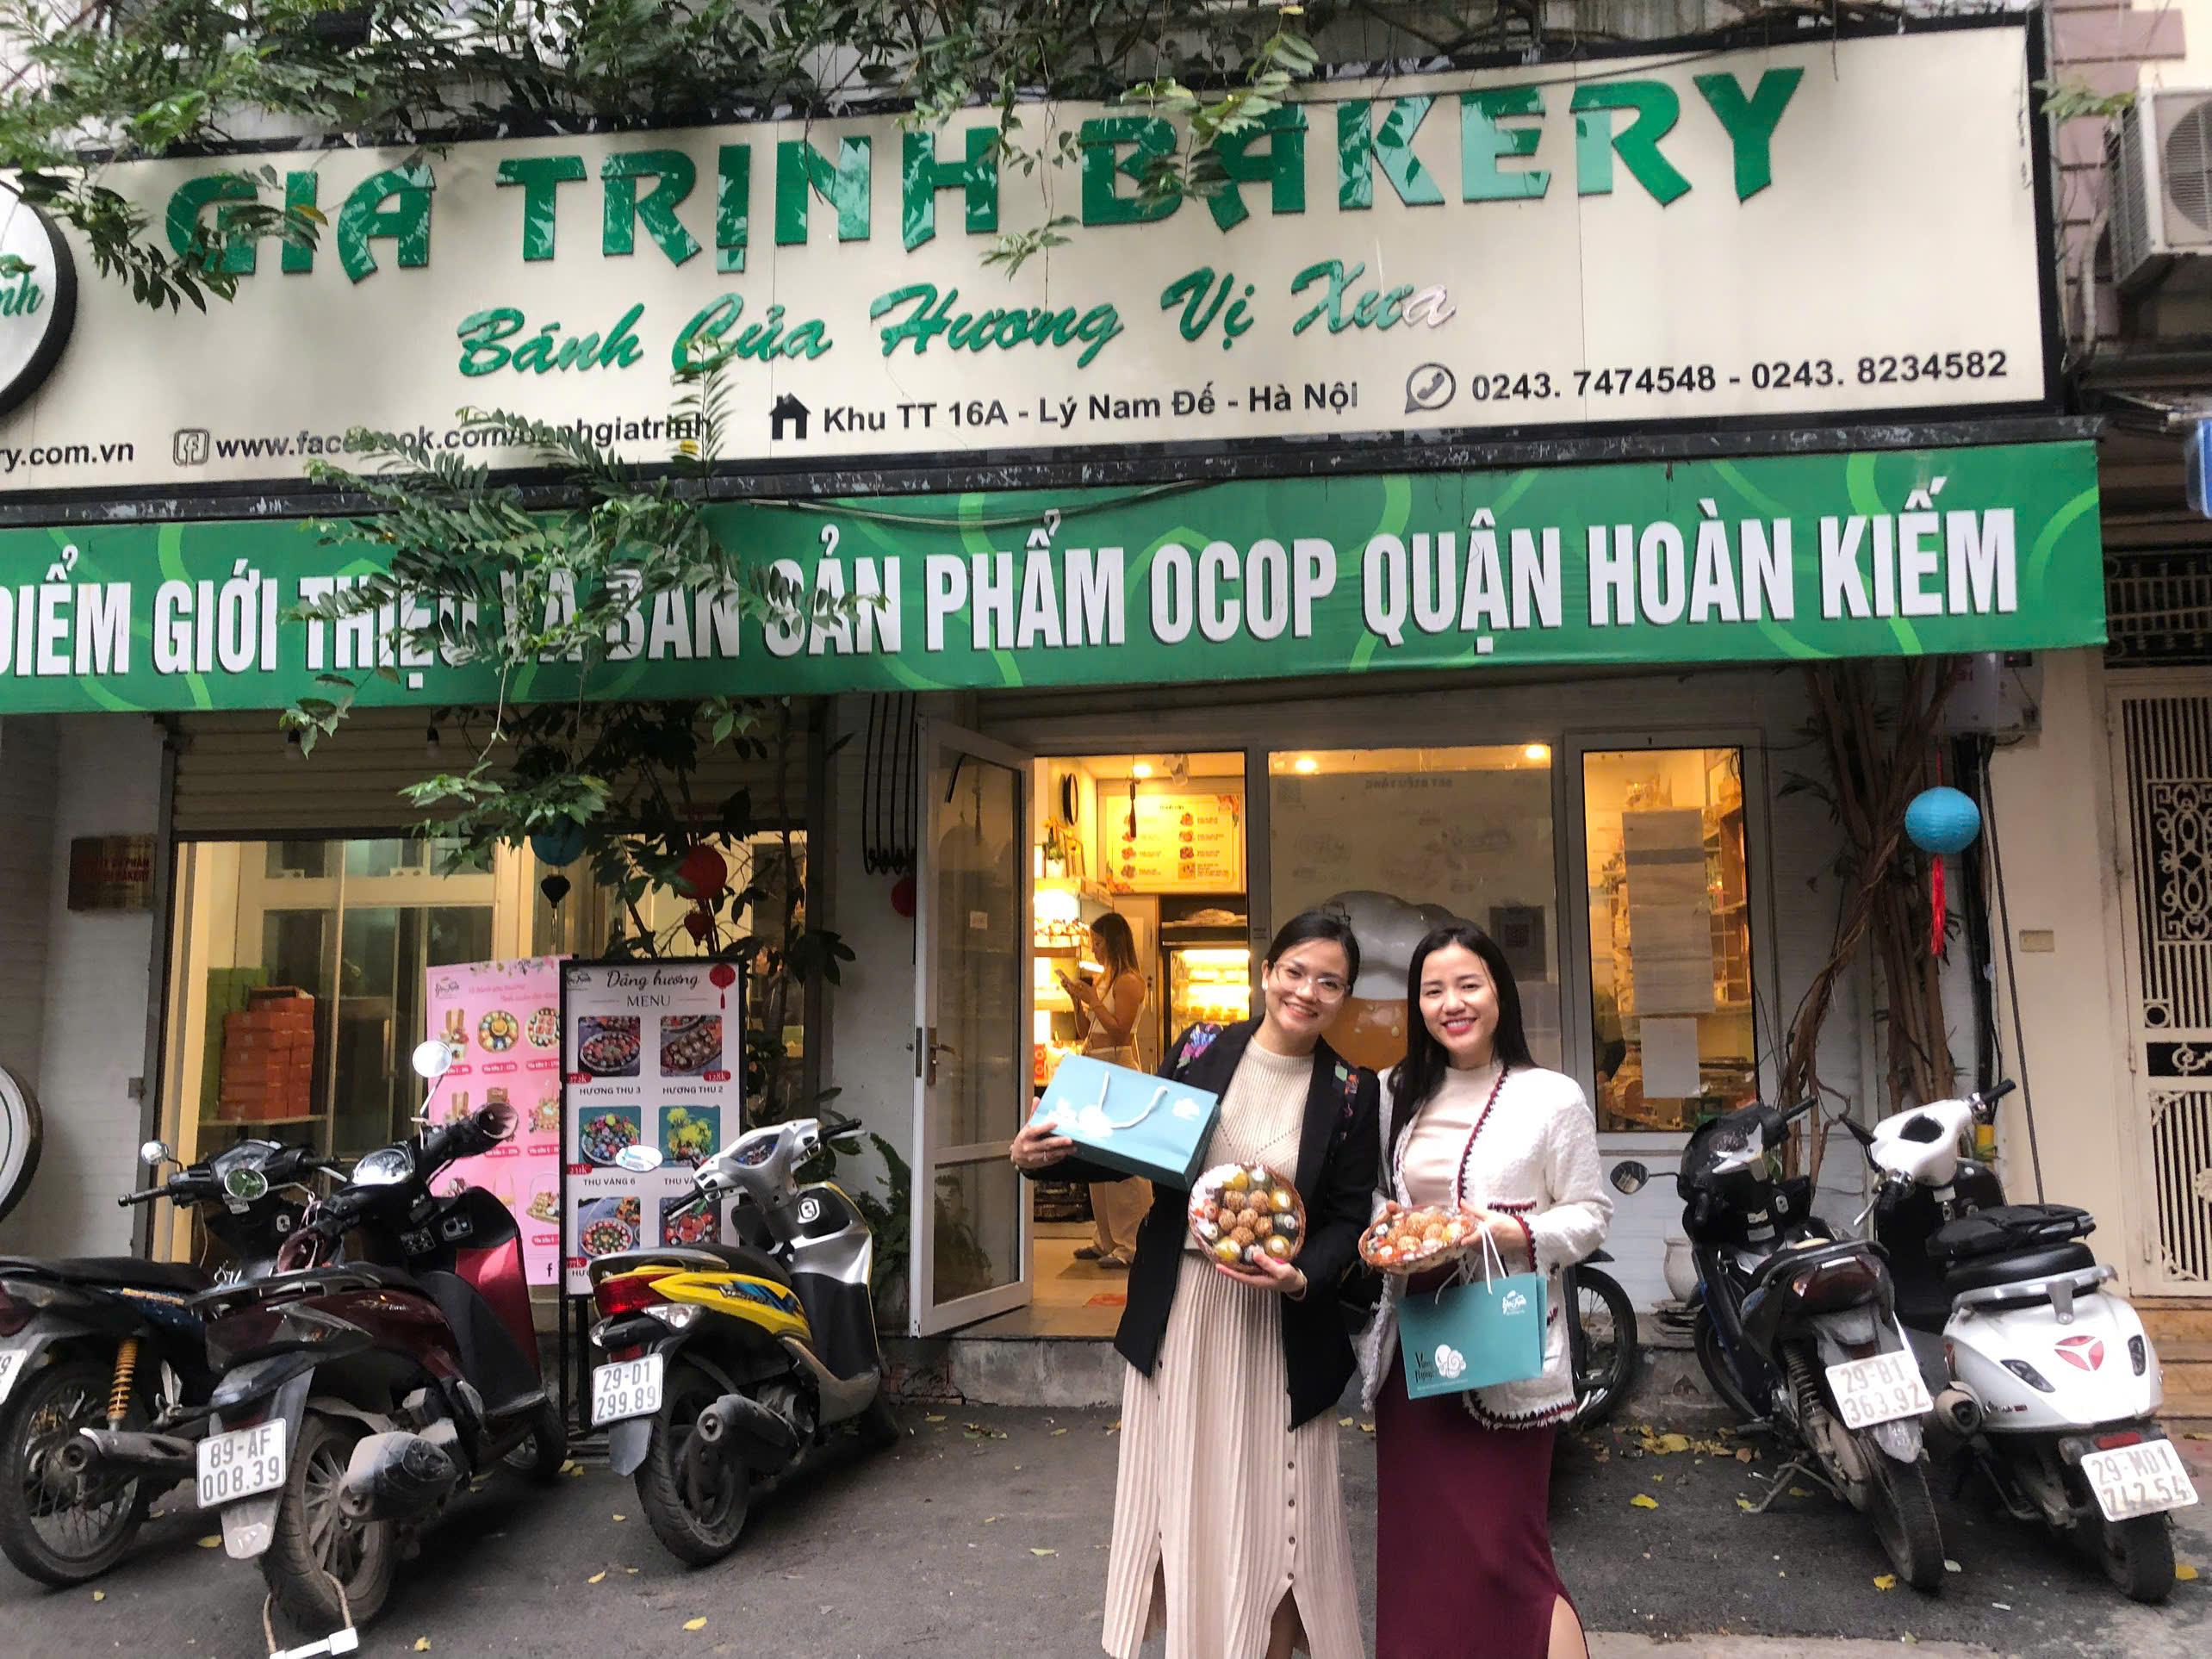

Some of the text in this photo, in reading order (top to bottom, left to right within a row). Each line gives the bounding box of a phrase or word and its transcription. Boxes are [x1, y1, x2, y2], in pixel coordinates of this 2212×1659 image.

[166, 66, 1805, 285] GIA TRỊNH BAKERY
[457, 258, 1457, 378] Bánh Của Hương Vị Xưa
[1471, 373, 1561, 402] 0243.
[1573, 363, 1717, 396] 7474548
[1751, 359, 1843, 391] 0243.
[1857, 350, 2008, 385] 8234582
[823, 402, 886, 434] Khu
[896, 404, 937, 430] TT
[948, 399, 1010, 428] 16A
[1039, 395, 1077, 429] Lý
[1089, 393, 1162, 423] Nam
[1171, 380, 1215, 419] Đế
[1248, 384, 1293, 413] Hà
[1303, 382, 1358, 413] Nội
[152, 558, 278, 674] GIỚI
[762, 522, 902, 658] SẢN
[924, 508, 1125, 652] PHẨM
[1150, 536, 1337, 646] OCOP
[1364, 507, 1563, 655] QUẬN
[1588, 497, 1794, 628] HOÀN
[1819, 475, 2018, 620] KIẾM
[626, 995, 672, 1007] MENU
[579, 1086, 614, 1096] HƯƠNG
[616, 1086, 634, 1095] THU
[662, 1085, 697, 1095] HƯƠNG
[698, 1085, 717, 1094] THU
[603, 1359, 651, 1390] 29-D1
[597, 1386, 656, 1420] 299.89
[209, 1427, 272, 1469] 89-AF
[202, 1455, 282, 1503] 008.39
